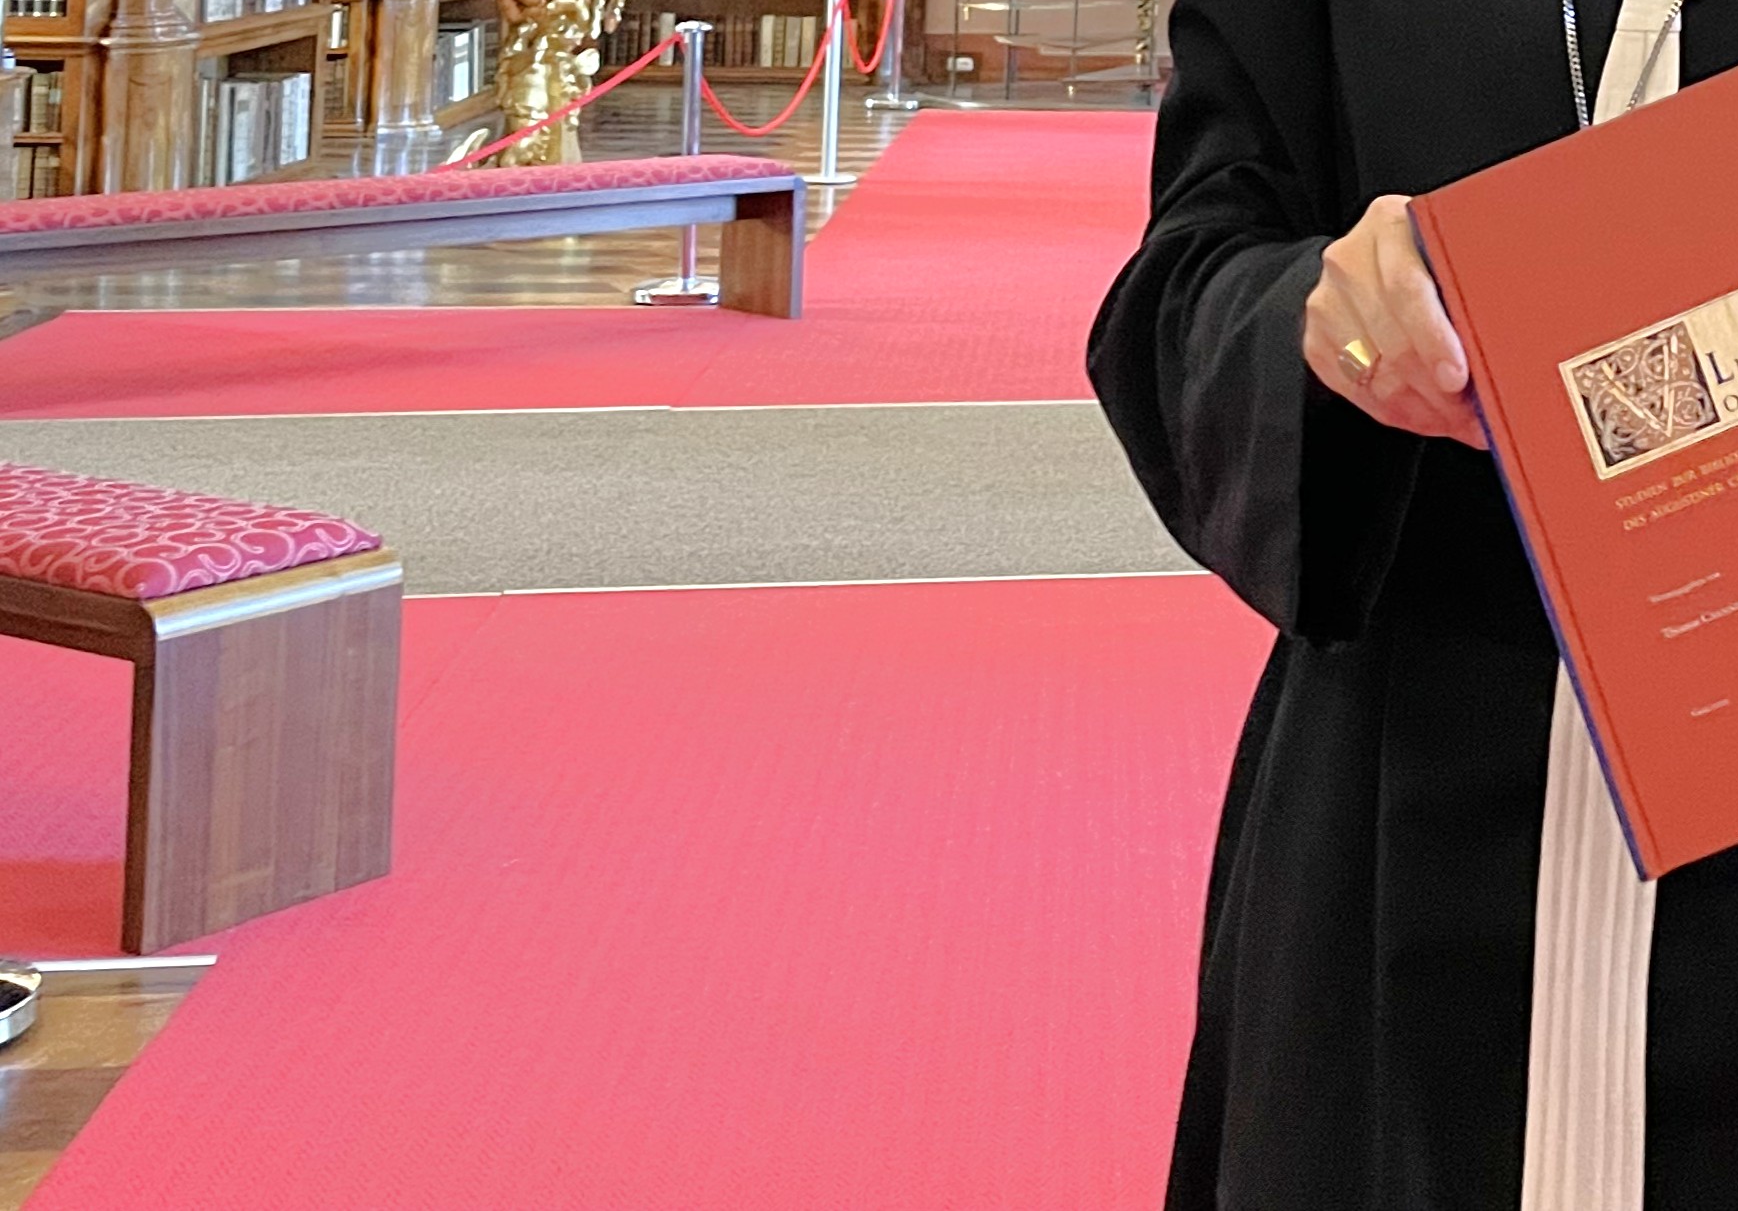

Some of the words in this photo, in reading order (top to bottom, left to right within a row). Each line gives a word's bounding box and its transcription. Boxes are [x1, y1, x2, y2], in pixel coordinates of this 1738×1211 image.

[1615, 481, 1668, 509] STUDIEN
[1671, 469, 1697, 487] ZUR
[1623, 513, 1647, 531] DES
[1651, 482, 1725, 521] AUGUSTINER
